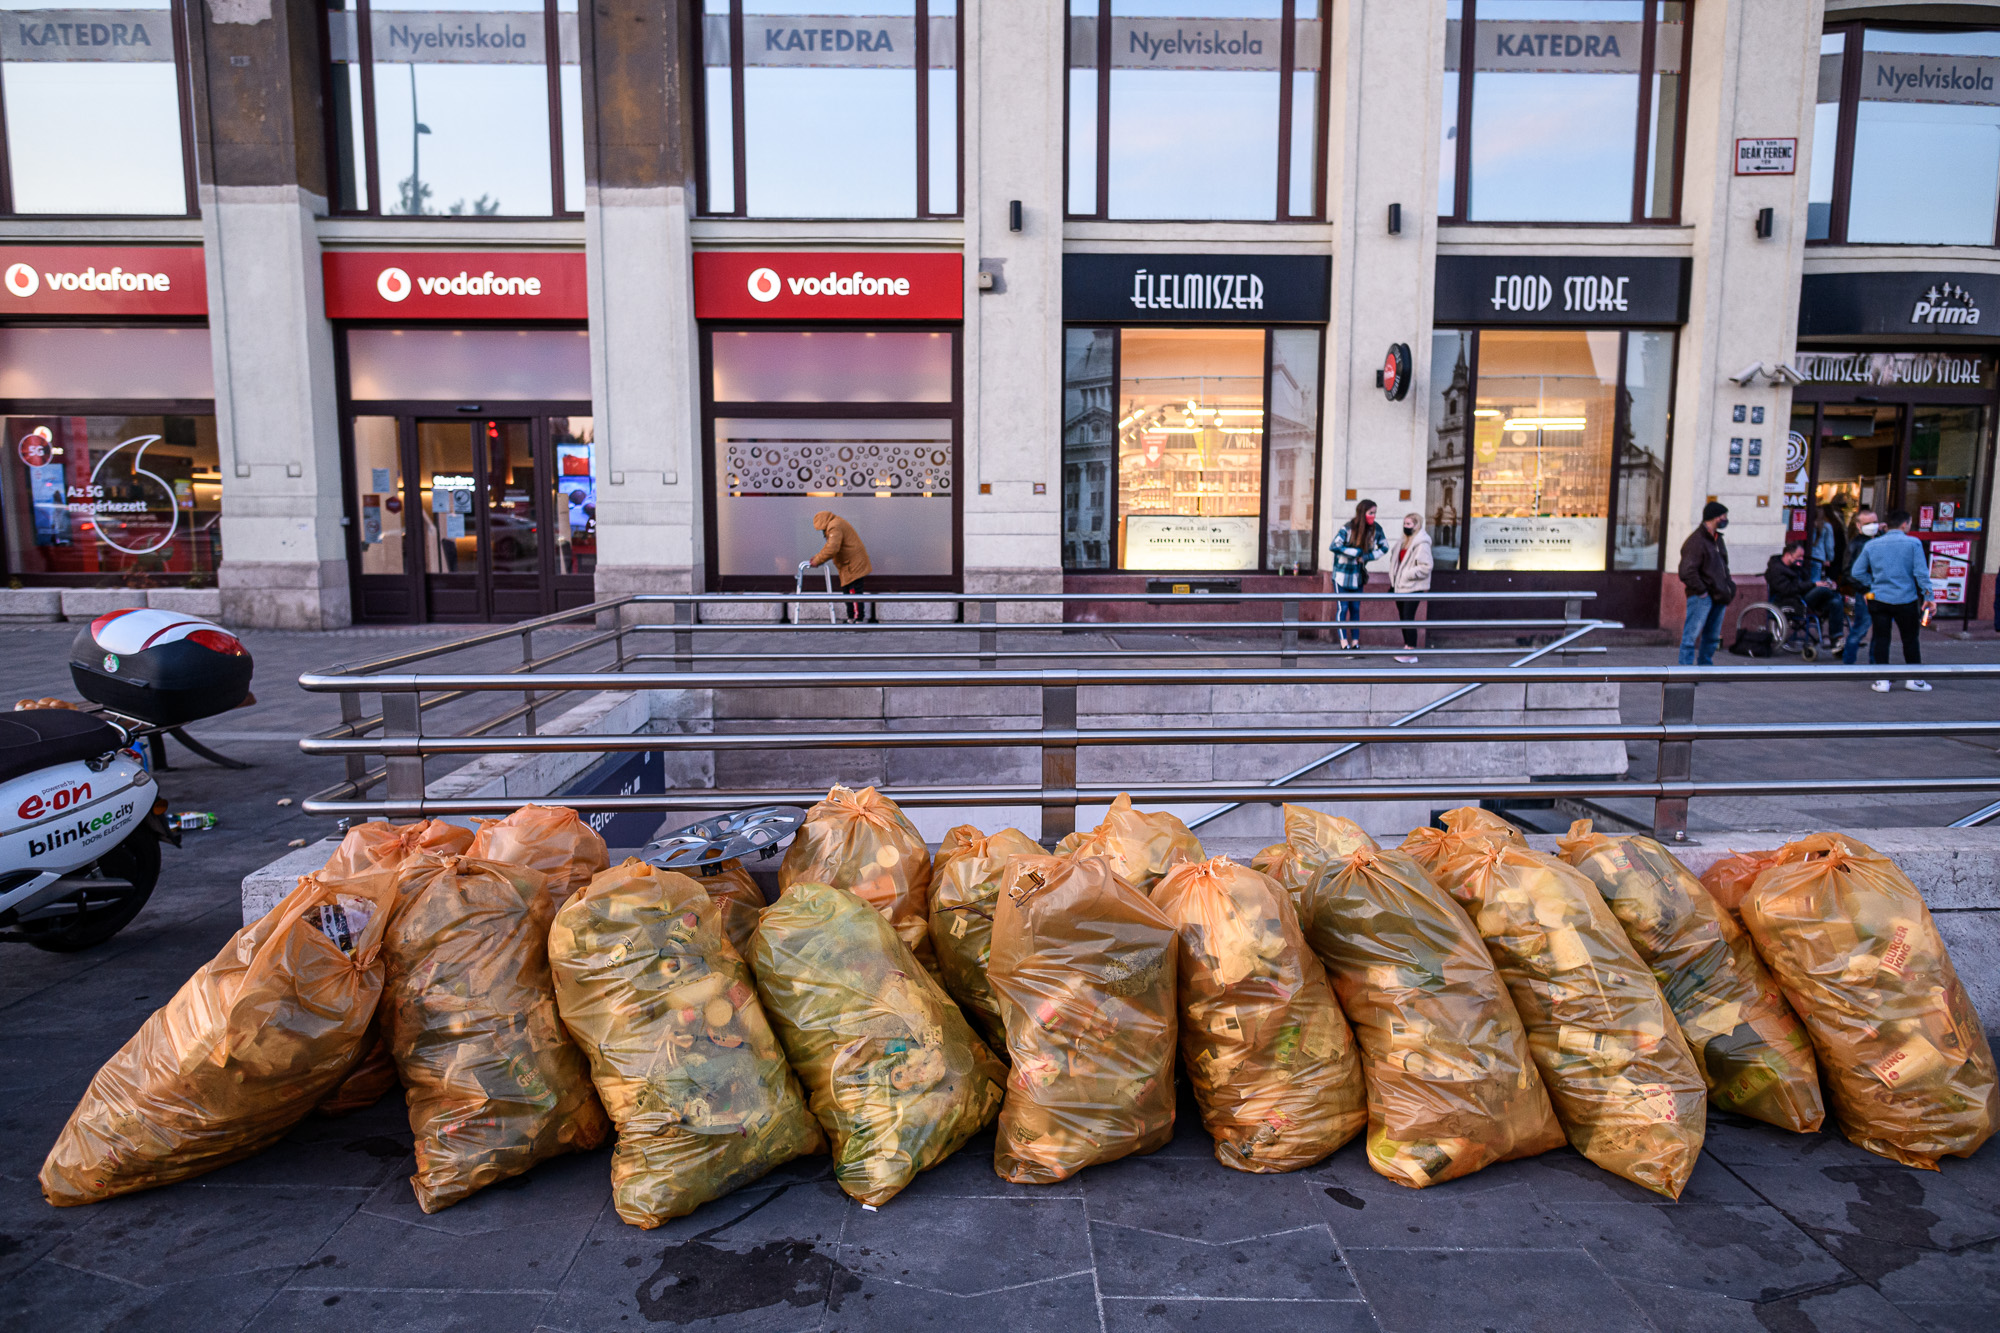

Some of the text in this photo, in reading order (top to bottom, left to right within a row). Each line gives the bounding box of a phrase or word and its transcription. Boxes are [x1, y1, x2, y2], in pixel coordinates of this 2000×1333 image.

[20, 23, 152, 47] KATEDRA
[389, 23, 527, 55] Nyelviskola
[765, 28, 894, 52] KATEDRA
[1129, 29, 1263, 61] Nyelviskola
[1496, 34, 1621, 58] KATEDRA
[1876, 64, 1994, 95] Nyelviskola
[1740, 146, 1792, 160] DEÁK FERENC
[44, 266, 170, 292] vodafone
[417, 271, 541, 296] vodafone
[787, 271, 910, 297] vodafone
[1130, 268, 1263, 311] ÉLELMISZER
[1491, 274, 1630, 312] FOOD STORE
[1893, 359, 1932, 384] FOOD
[1936, 359, 1982, 384] STORE
[28, 445, 45, 457] 5G
[67, 485, 104, 498] Az 5G
[68, 501, 148, 515] megérkezett
[42, 779, 76, 795] powered by
[28, 801, 134, 858] blinkee.city
[82, 815, 133, 847] 100% ELECTRIC
[1884, 924, 1908, 965] BURGER
[1893, 943, 1912, 969] KING
